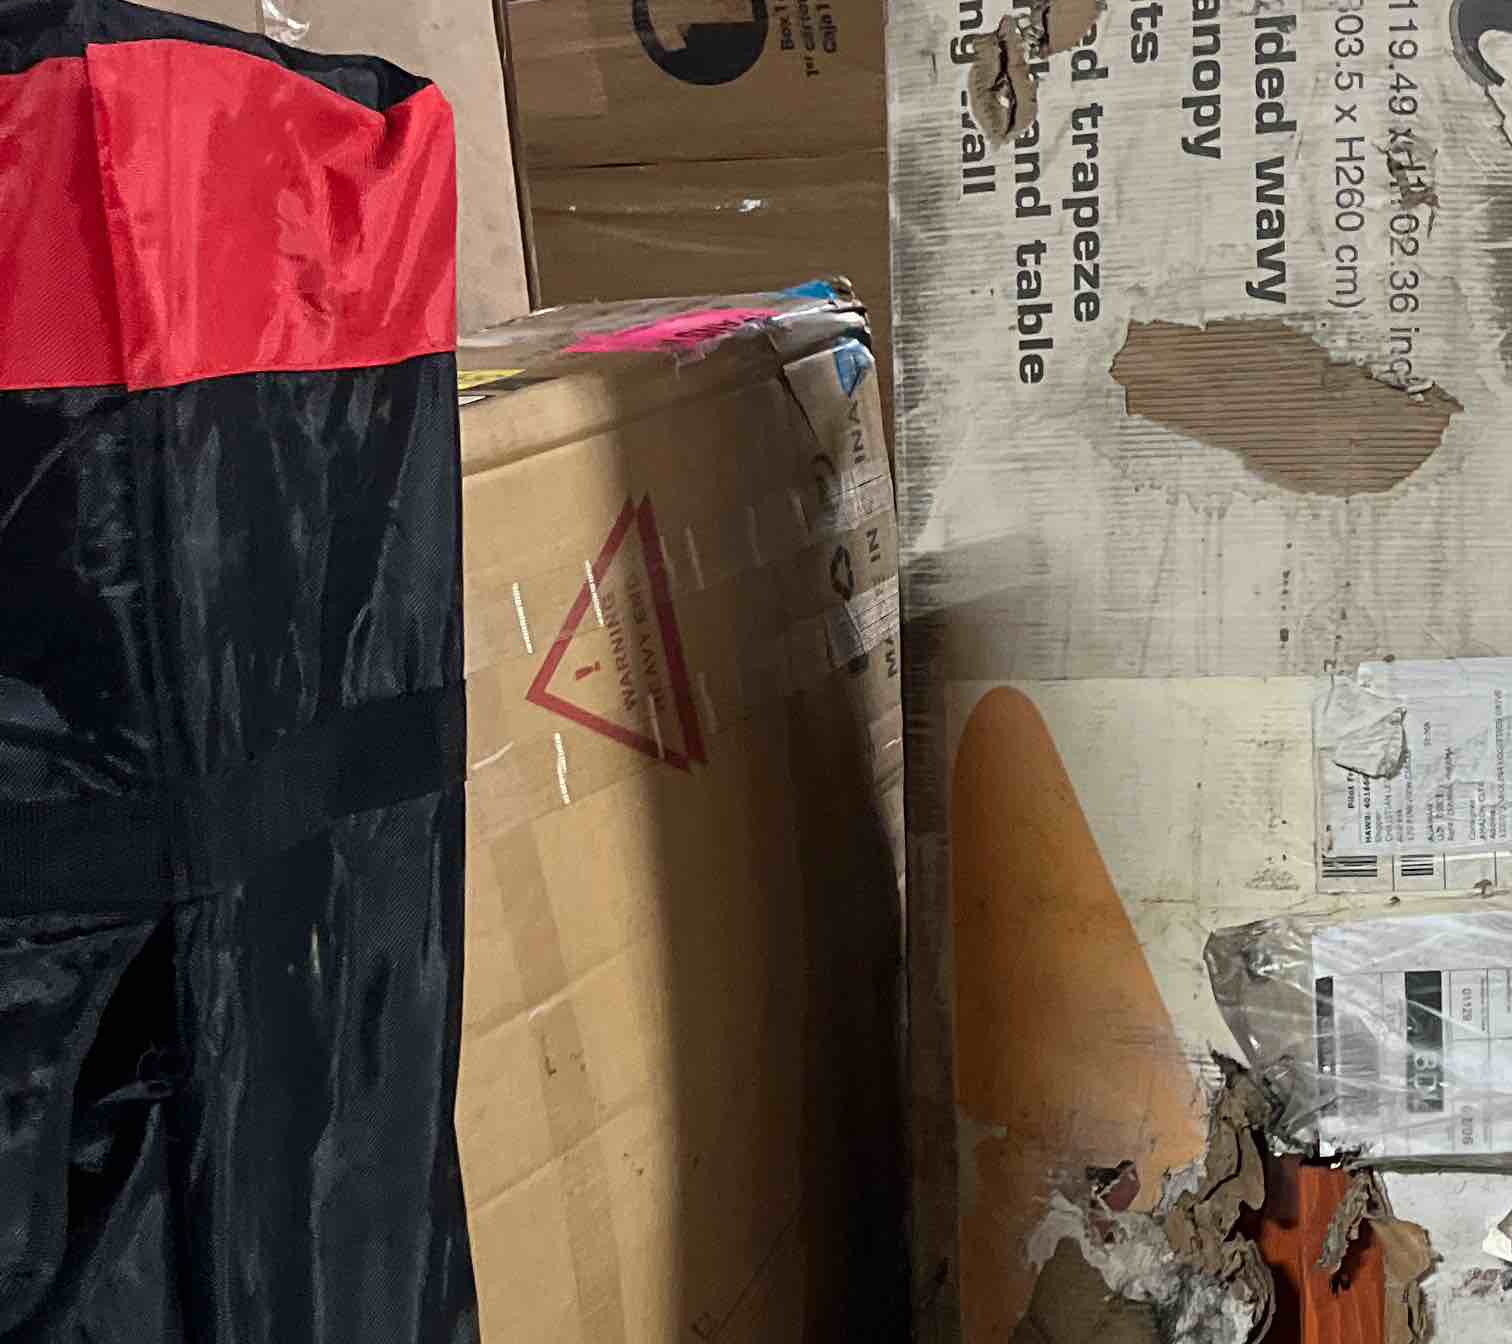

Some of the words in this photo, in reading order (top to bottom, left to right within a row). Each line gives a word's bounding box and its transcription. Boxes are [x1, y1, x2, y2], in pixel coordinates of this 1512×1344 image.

[961, 92, 996, 195] all
[1334, 104, 1358, 124] x
[1062, 101, 1105, 323] trapeze
[1246, 157, 1290, 304] wavy
[1333, 135, 1366, 232] H260
[1017, 240, 1053, 384] table
[1328, 243, 1366, 309] cm)
